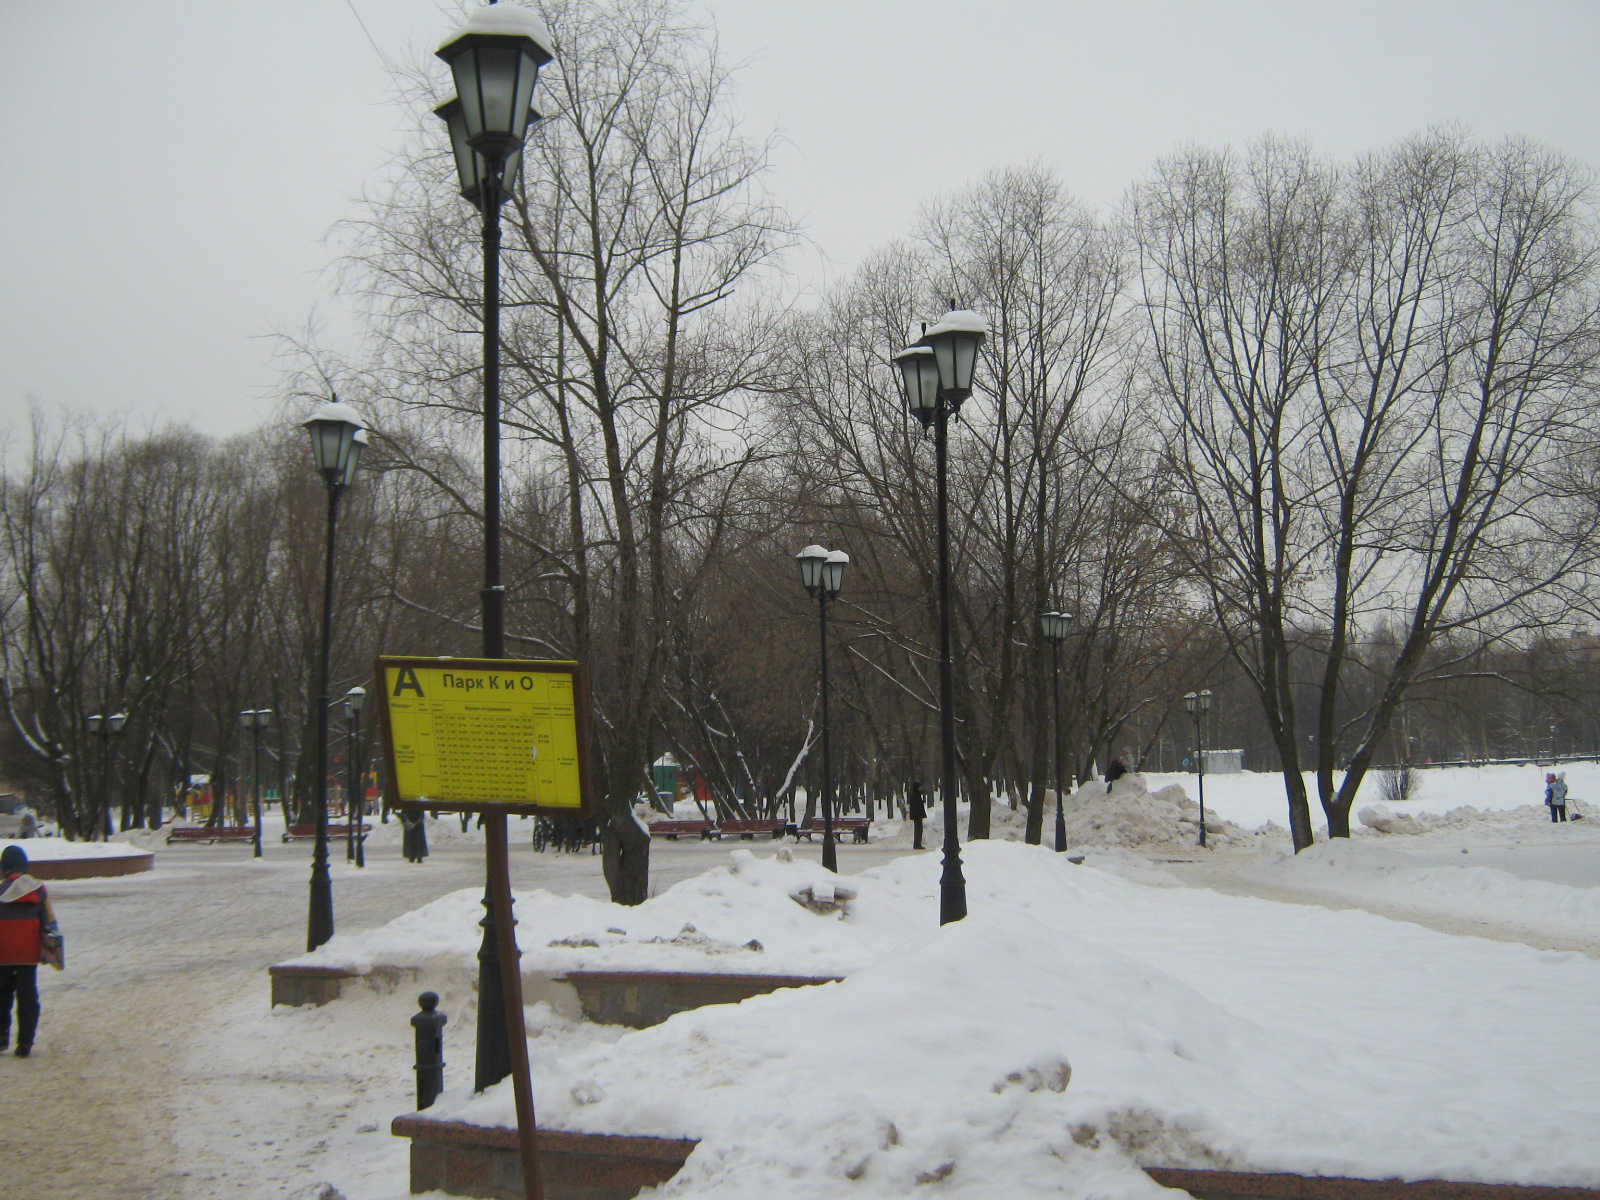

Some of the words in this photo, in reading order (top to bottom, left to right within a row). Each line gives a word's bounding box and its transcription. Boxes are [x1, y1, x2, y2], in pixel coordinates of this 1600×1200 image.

[393, 667, 425, 697] А
[443, 674, 484, 692] Парк
[489, 676, 499, 689] К
[504, 680, 515, 690] и
[520, 676, 534, 690] О
